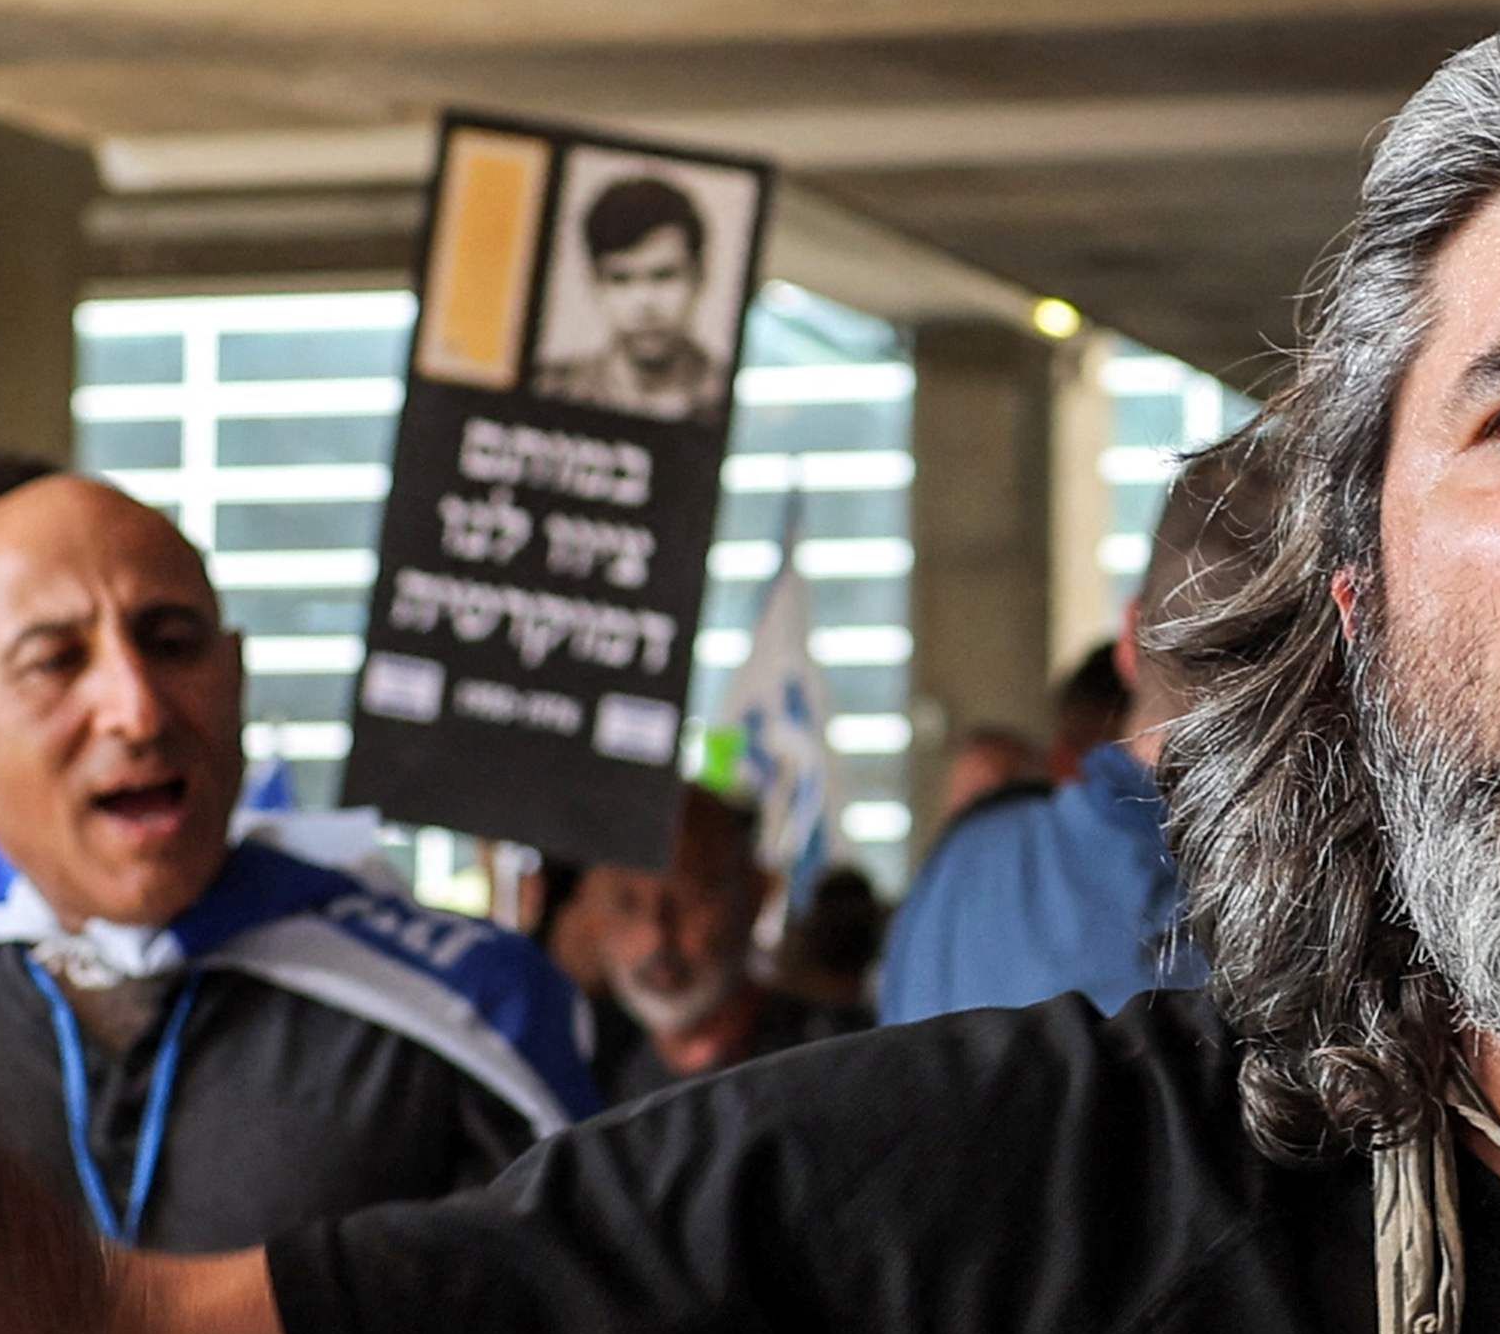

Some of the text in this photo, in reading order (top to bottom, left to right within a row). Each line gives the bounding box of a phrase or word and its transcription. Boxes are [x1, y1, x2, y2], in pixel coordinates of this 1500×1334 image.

[460, 419, 652, 506] במותם
[437, 484, 534, 563] לנו
[392, 567, 677, 673] דמוקרטיה
